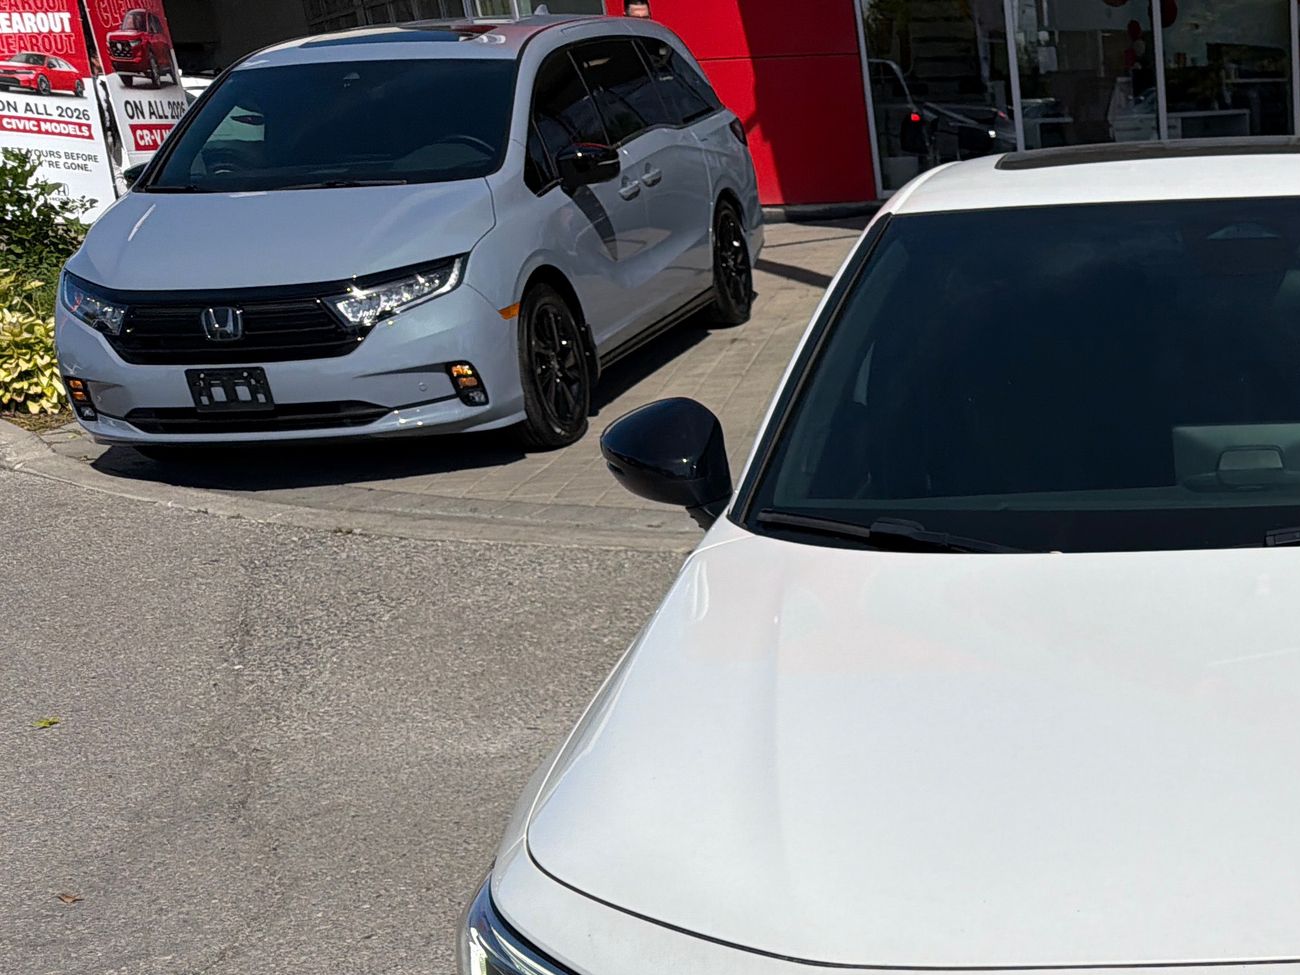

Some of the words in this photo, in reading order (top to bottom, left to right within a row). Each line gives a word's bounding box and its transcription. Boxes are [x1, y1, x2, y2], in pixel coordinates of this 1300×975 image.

[0, 33, 76, 55] EAROUT
[24, 102, 53, 116] ALL
[56, 105, 91, 121] 2026
[124, 100, 146, 120] ON
[148, 100, 169, 120] ALL
[2, 118, 39, 131] CIVIC
[39, 121, 90, 136] MODELS
[135, 129, 161, 146] CR-V
[64, 151, 99, 163] BEFORE
[63, 161, 92, 172] GONE.
